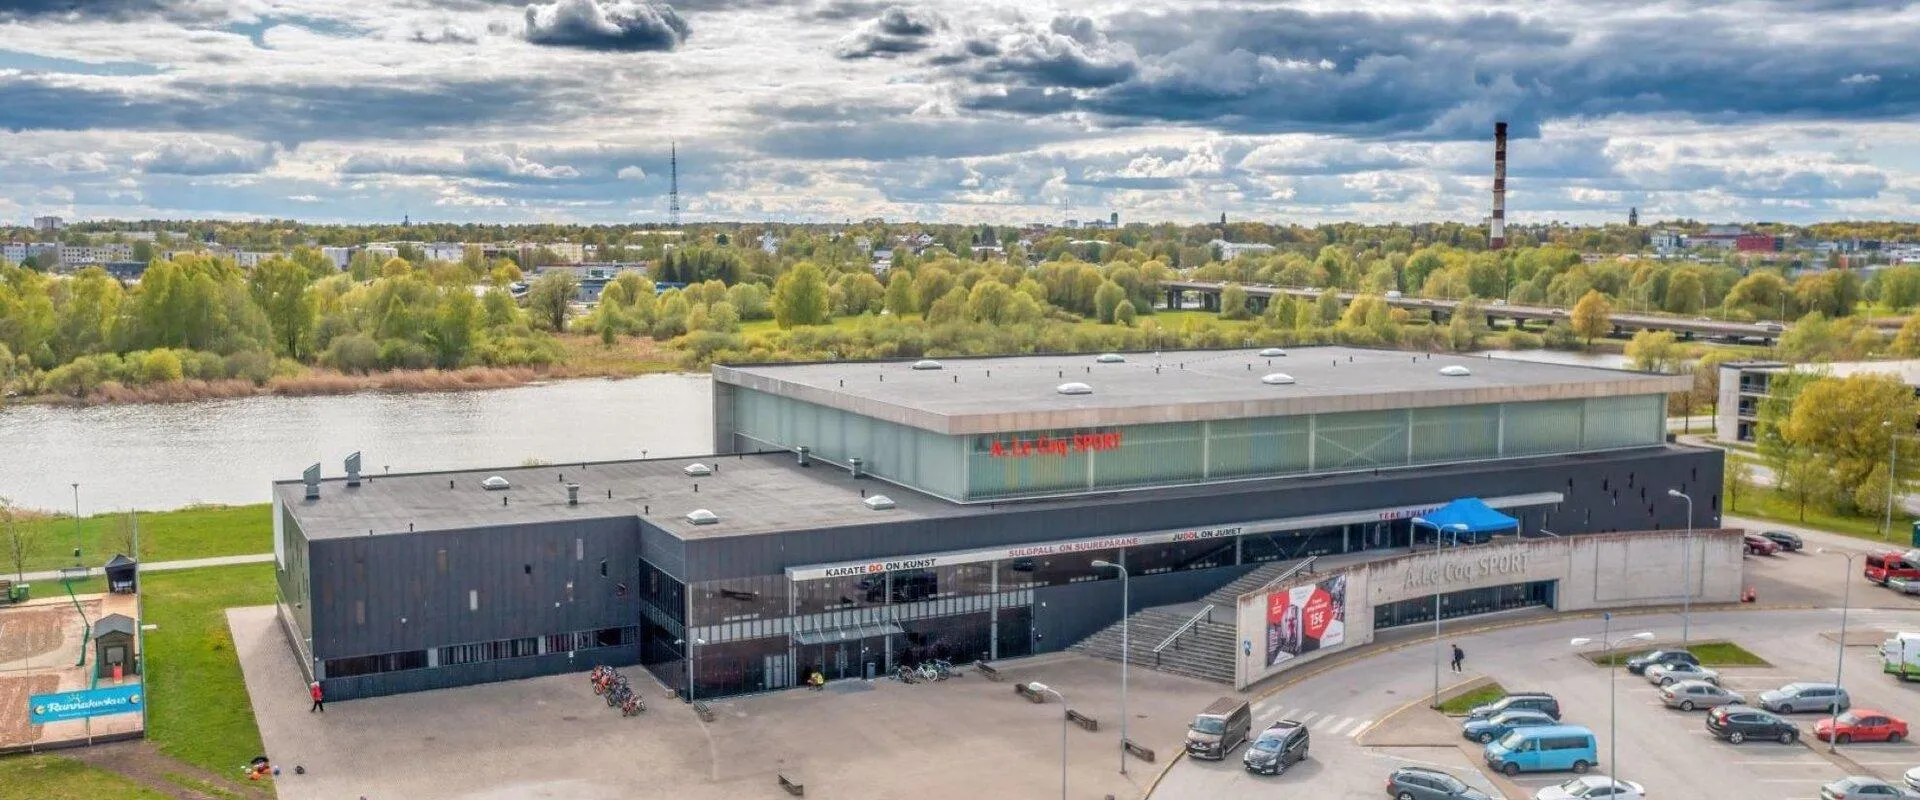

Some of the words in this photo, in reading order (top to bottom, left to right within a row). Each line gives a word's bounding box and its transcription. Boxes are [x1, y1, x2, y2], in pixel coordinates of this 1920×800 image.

[1073, 433, 1121, 450] SPORT
[1201, 530, 1213, 538] ON
[1008, 546, 1053, 557] SULGPALL
[1059, 544, 1072, 552] ON
[825, 565, 867, 577] KARATE
[868, 564, 883, 573] DO
[885, 562, 900, 571] ON
[903, 558, 937, 569] KUNST
[1444, 562, 1472, 583] Coq
[1479, 550, 1530, 576] SPORT
